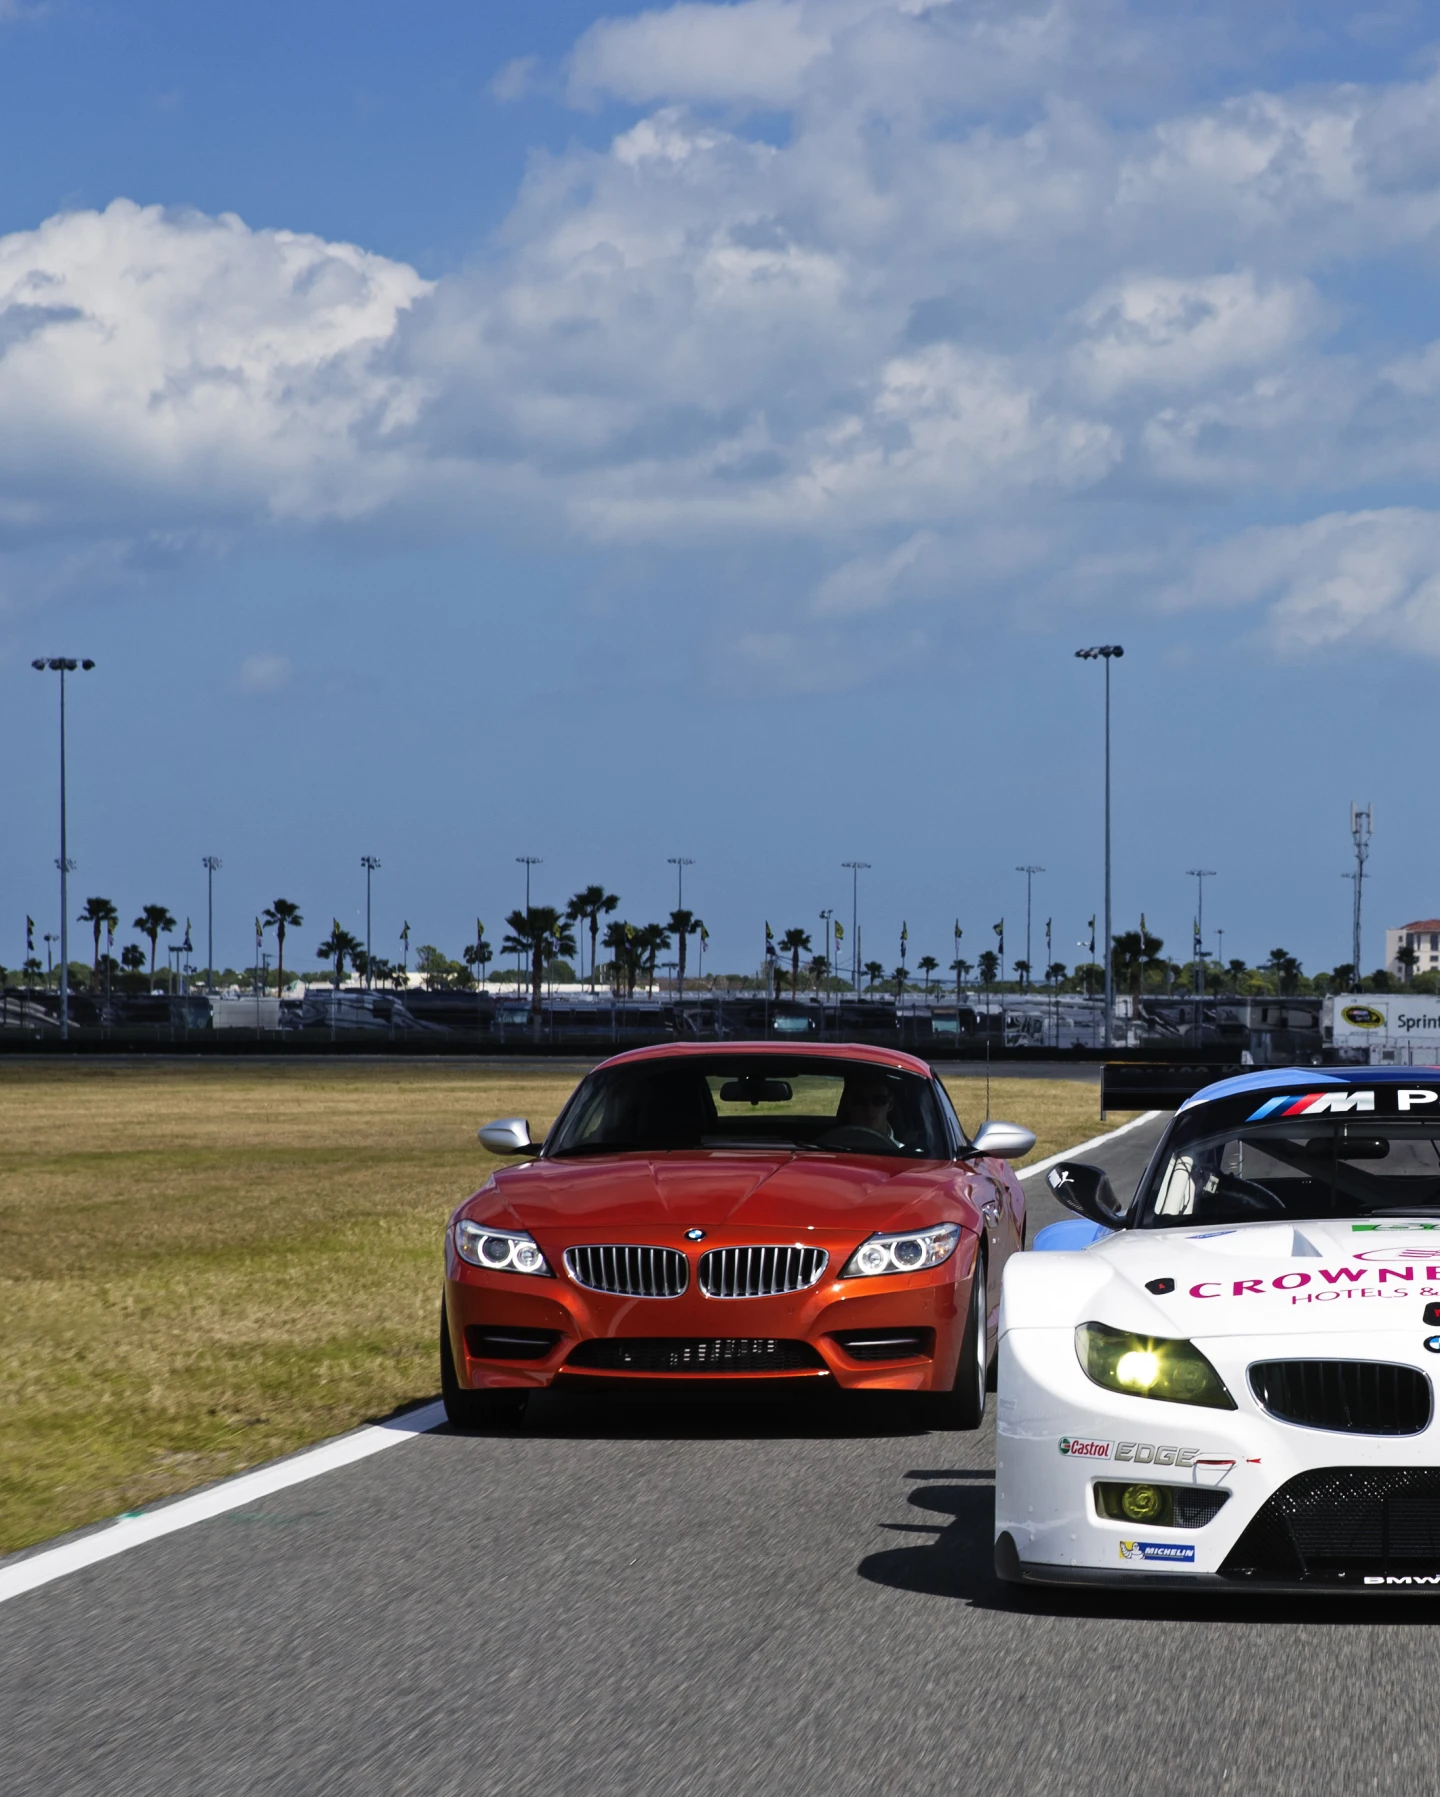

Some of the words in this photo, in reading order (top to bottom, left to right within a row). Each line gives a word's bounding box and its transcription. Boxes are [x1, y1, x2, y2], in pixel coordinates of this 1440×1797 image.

[1291, 1287, 1409, 1305] HOTELS
[1419, 1286, 1439, 1297] &
[1070, 1439, 1111, 1458] Castrol
[1114, 1441, 1200, 1467] EDGE
[1144, 1546, 1194, 1558] MICHELIN
